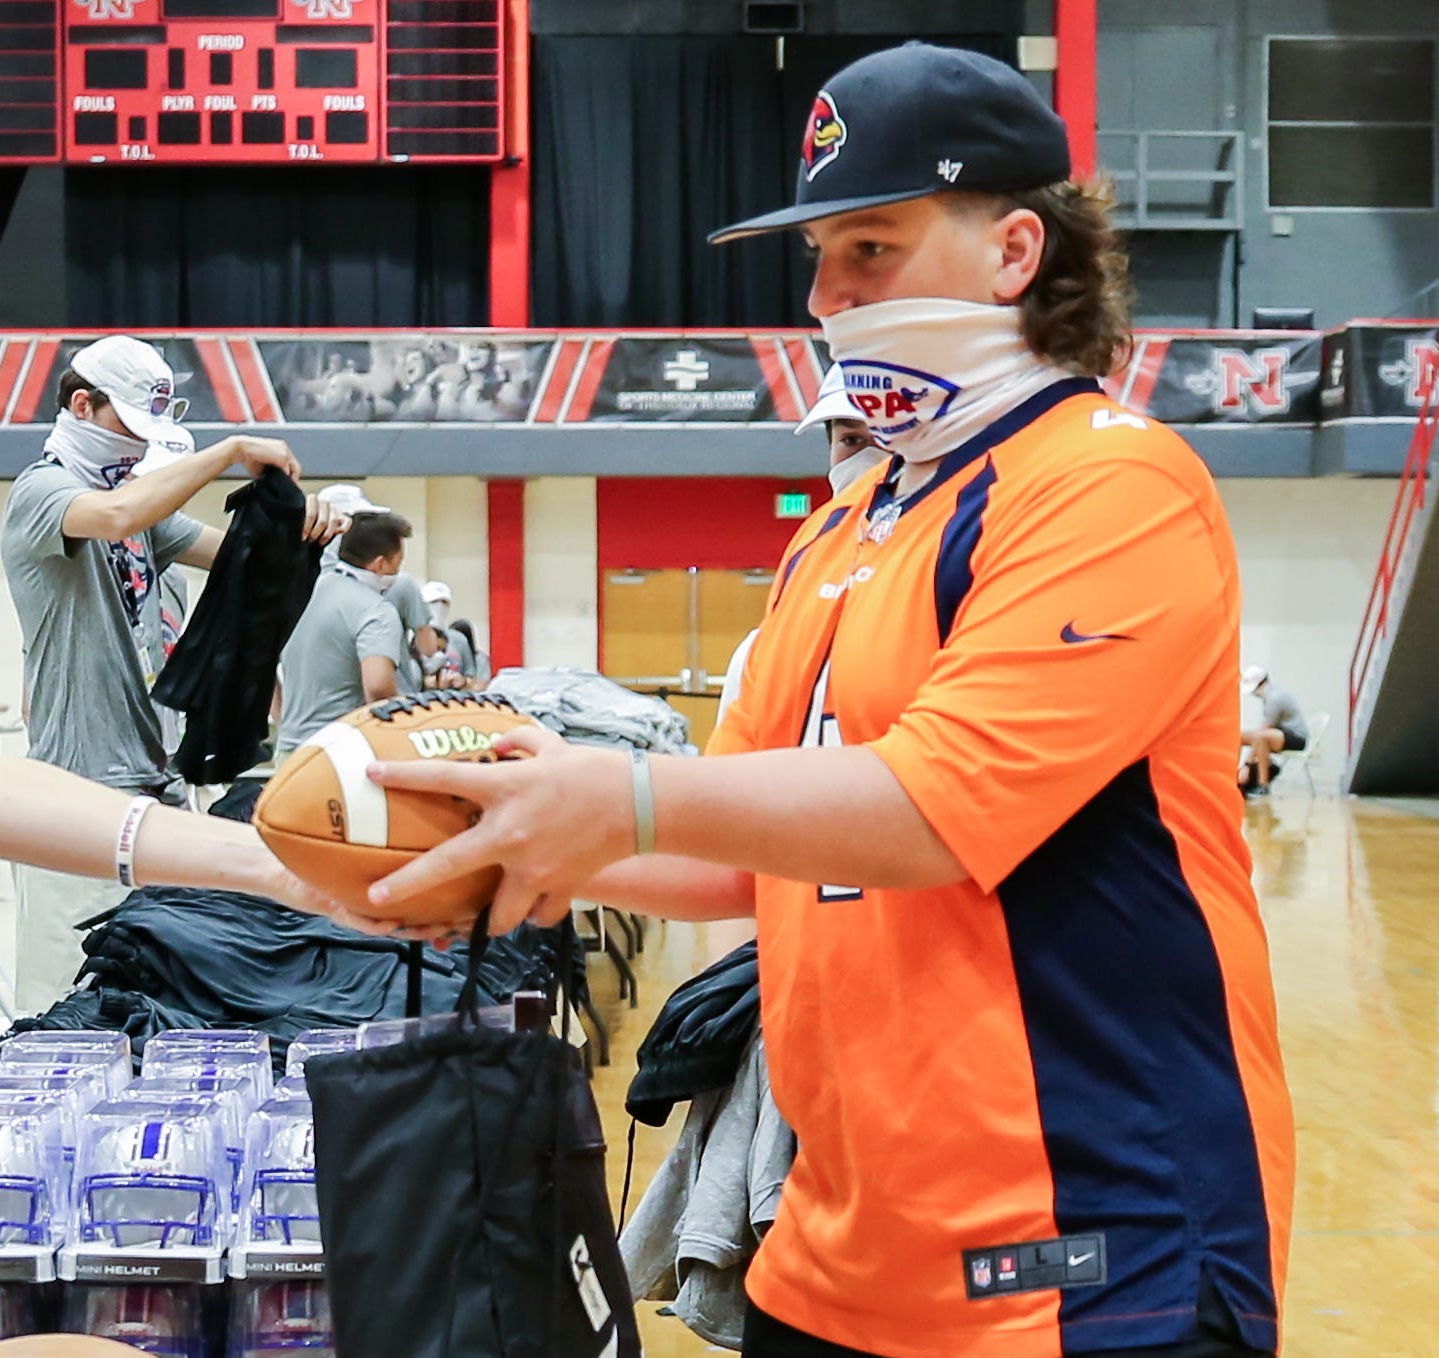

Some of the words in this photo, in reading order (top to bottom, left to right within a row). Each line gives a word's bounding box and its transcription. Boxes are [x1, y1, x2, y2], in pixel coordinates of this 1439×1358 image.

[198, 35, 244, 50] PERIOD
[74, 96, 115, 111] FOULS
[162, 96, 195, 111] PLYR
[204, 96, 237, 111] FOUL
[251, 95, 277, 110] PTS
[324, 95, 365, 110] FOULS
[121, 144, 155, 160] T.O.L.
[289, 144, 323, 160] T.O.L.
[617, 392, 660, 401] SPORTS
[662, 392, 710, 401] MEDICINE
[714, 391, 756, 401] CENTER
[408, 725, 503, 758] Wils
[327, 799, 346, 842] GST
[76, 1265, 102, 1275] MINI
[104, 1265, 161, 1276] HELMET
[246, 1262, 273, 1272] MINI
[275, 1262, 325, 1272] HELME
